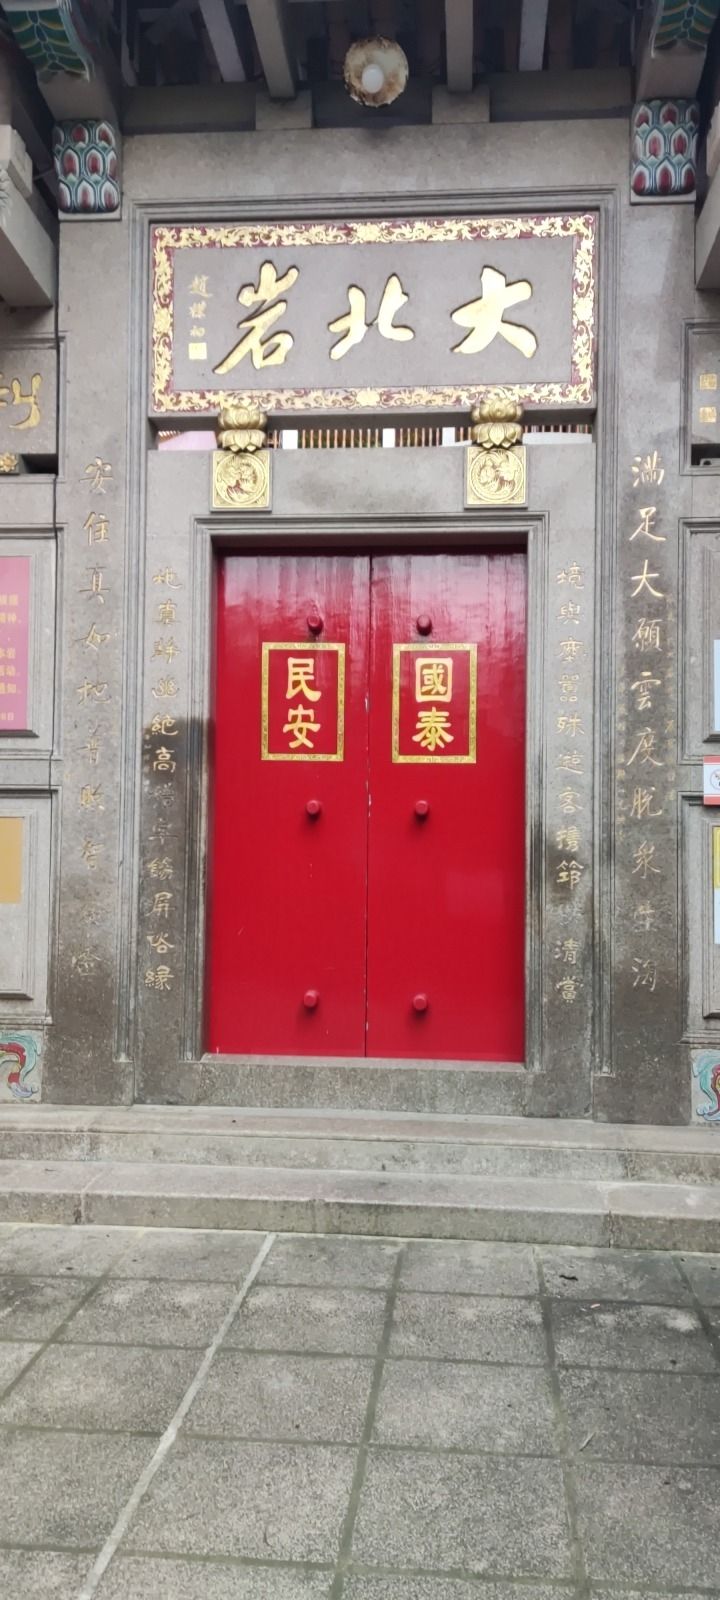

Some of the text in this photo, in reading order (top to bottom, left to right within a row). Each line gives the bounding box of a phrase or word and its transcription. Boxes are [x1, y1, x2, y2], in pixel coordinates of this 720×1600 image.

[212, 259, 539, 376] 大北岩
[282, 656, 322, 749] 民安
[411, 657, 455, 752] 國泰
